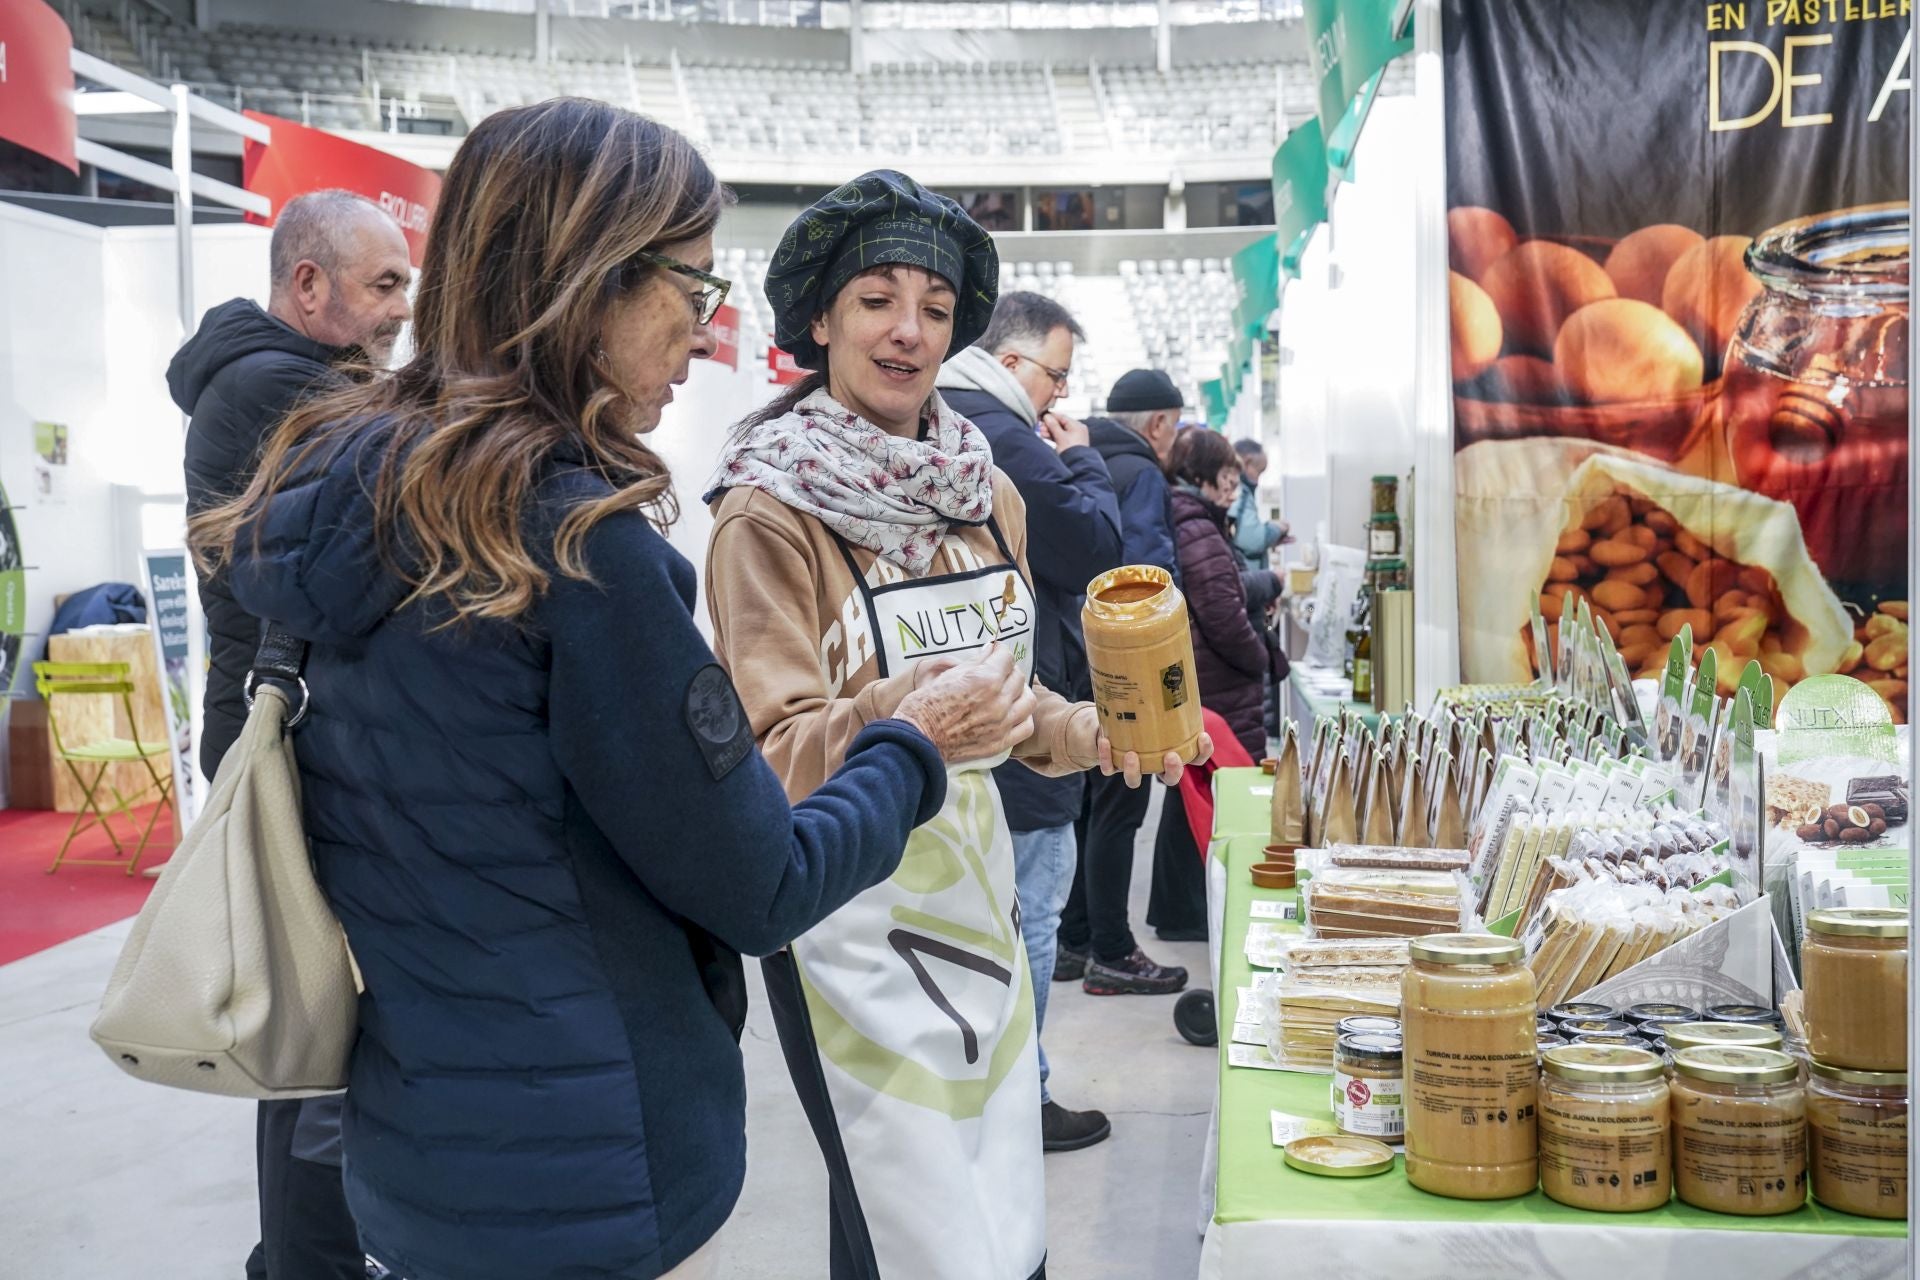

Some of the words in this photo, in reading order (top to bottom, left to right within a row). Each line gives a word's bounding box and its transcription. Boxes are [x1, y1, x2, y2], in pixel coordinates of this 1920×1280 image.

[1707, 2, 1745, 31] EN
[1709, 33, 1834, 132] DE
[874, 220, 926, 235] COFFEE
[896, 595, 1028, 652] NUTXES
[1562, 1111, 1570, 1119] DE
[1572, 1113, 1595, 1122] JIJONA
[1868, 1119, 1879, 1128] DE
